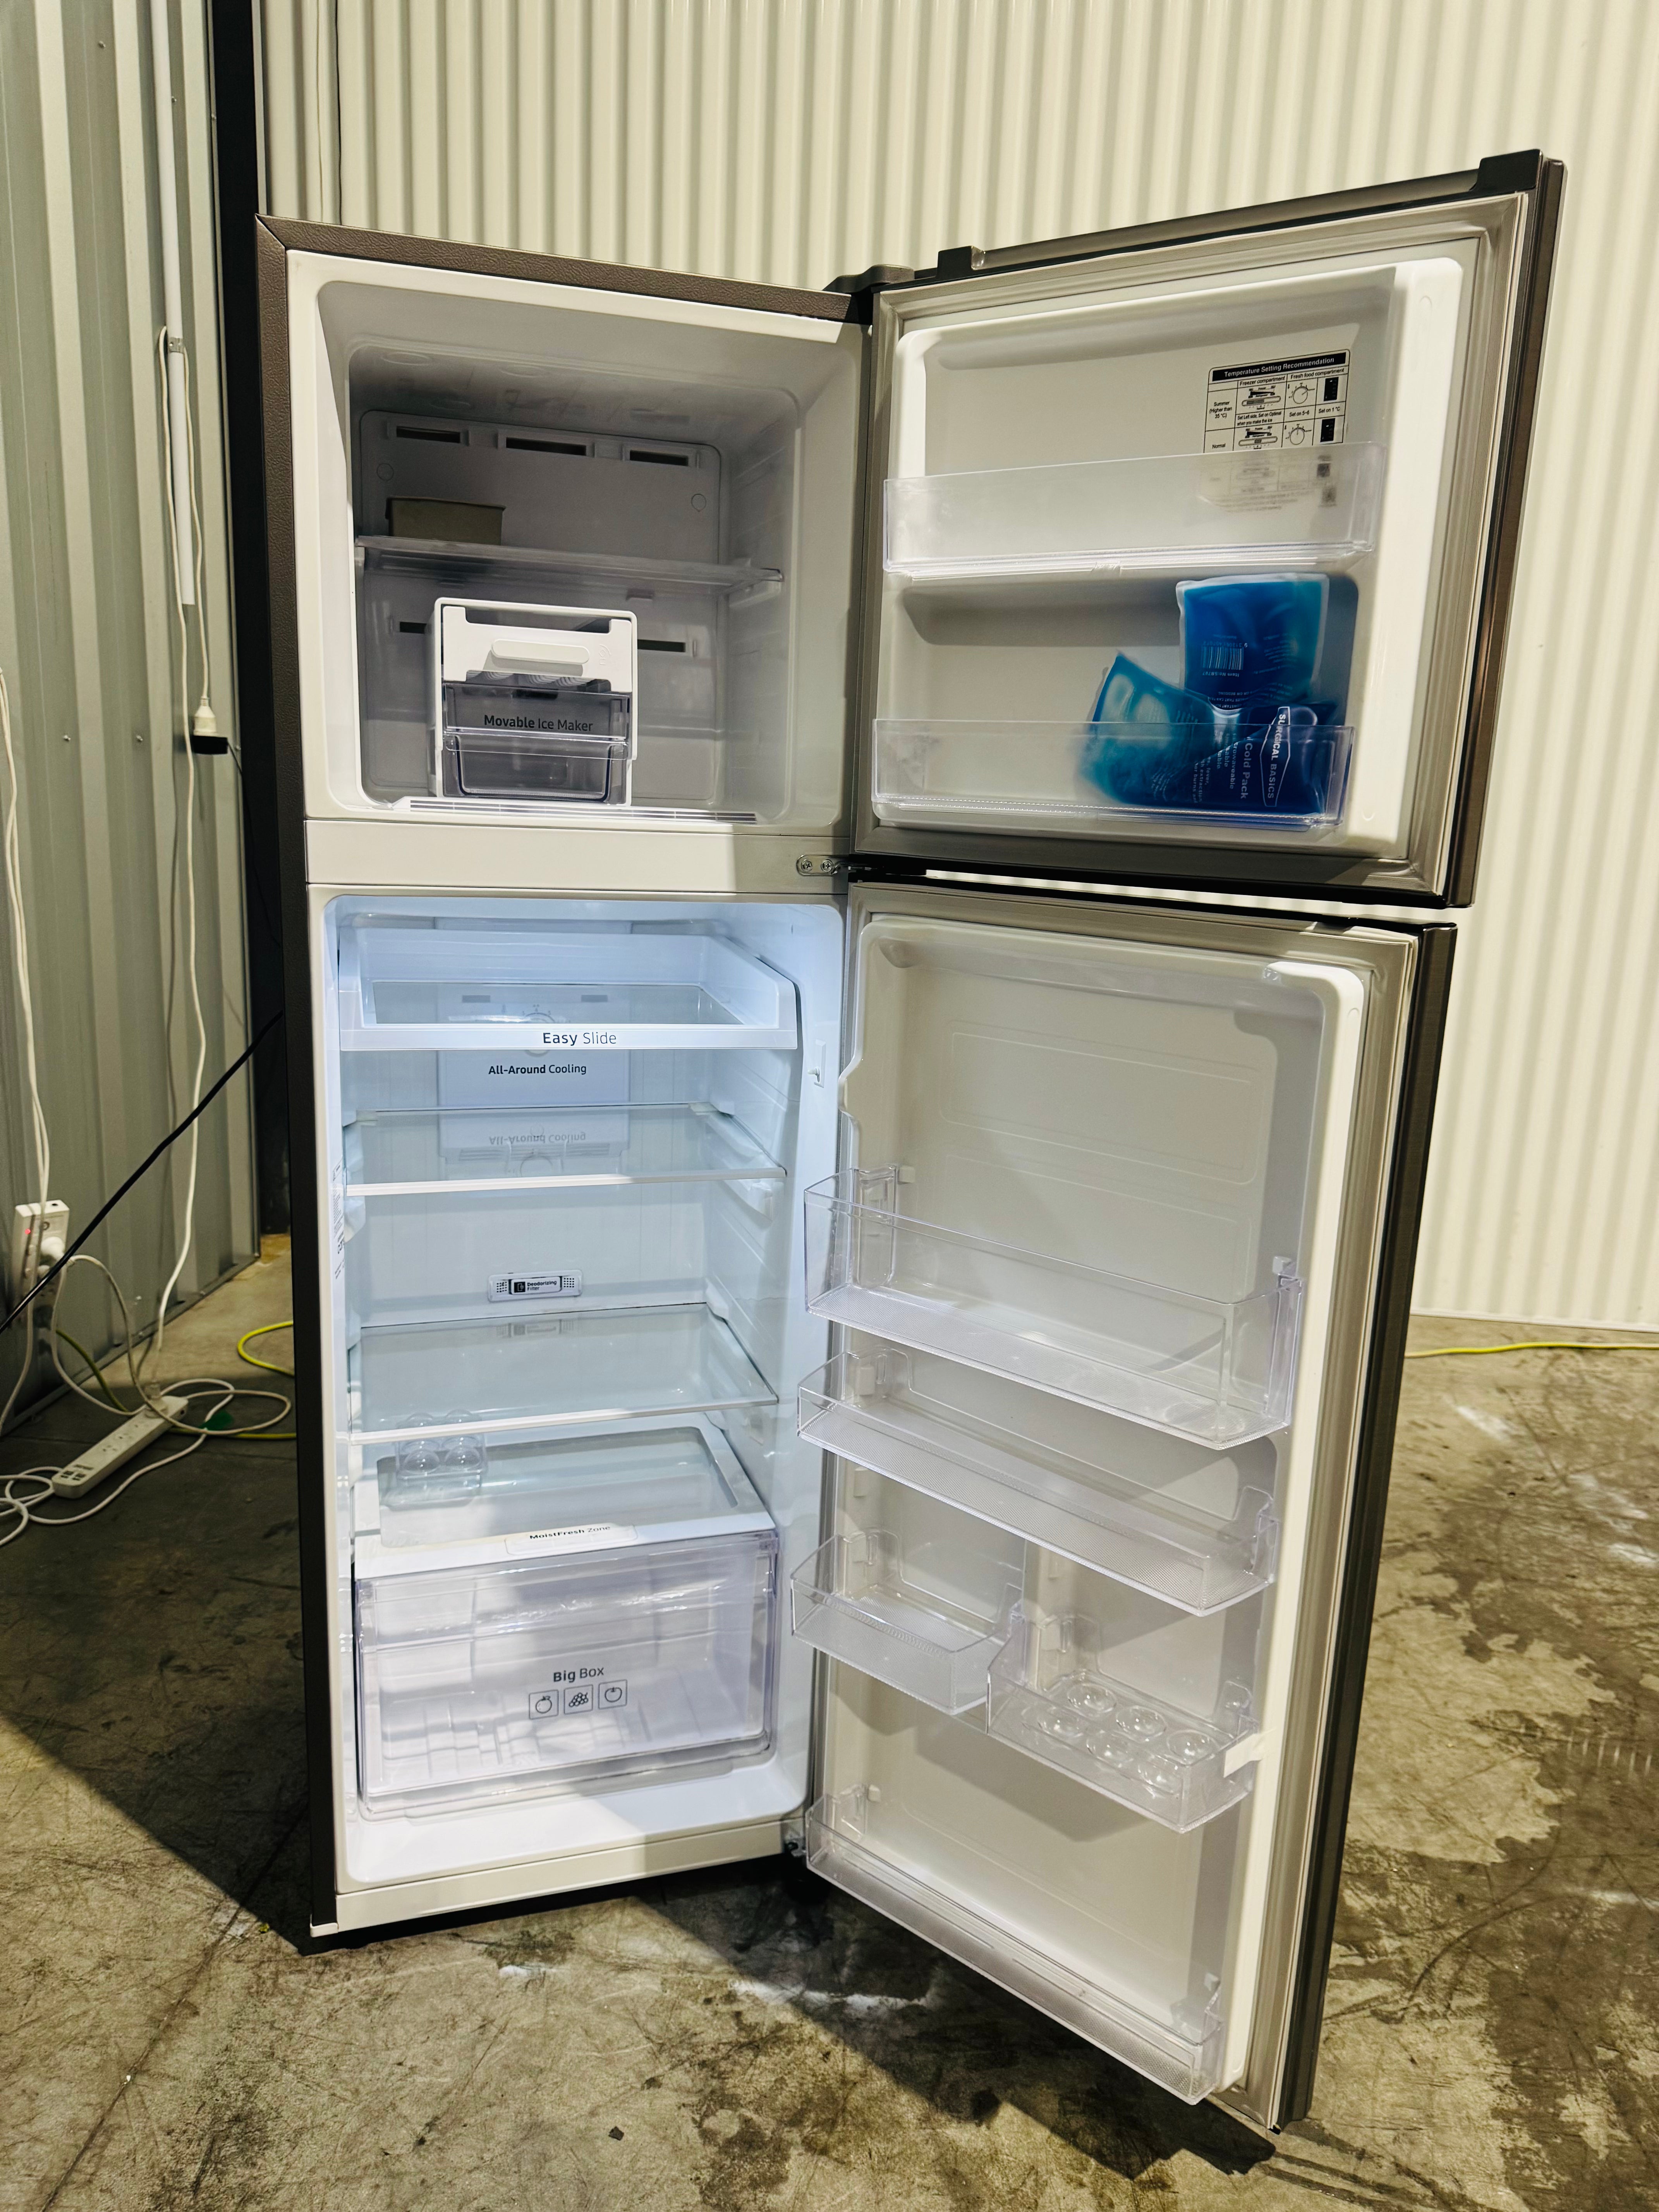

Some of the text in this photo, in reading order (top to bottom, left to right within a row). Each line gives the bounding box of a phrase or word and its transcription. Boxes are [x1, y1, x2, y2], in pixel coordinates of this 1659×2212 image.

[1224, 368, 1260, 377] Temperature
[1283, 358, 1334, 369] Recommendation
[1315, 368, 1344, 376] compartment
[1257, 376, 1285, 385] compartment
[484, 714, 593, 732] Movable Ice Maker
[1271, 714, 1286, 761] SURGICAL
[1243, 743, 1253, 768] Cold
[1240, 771, 1250, 799] Pack
[1268, 764, 1277, 799] BASICS
[543, 1032, 617, 1046] Easy Slide
[488, 1064, 587, 1075] All-Around Cooling
[530, 1528, 584, 1539] MoistFresh
[553, 1667, 604, 1683] Big Box
